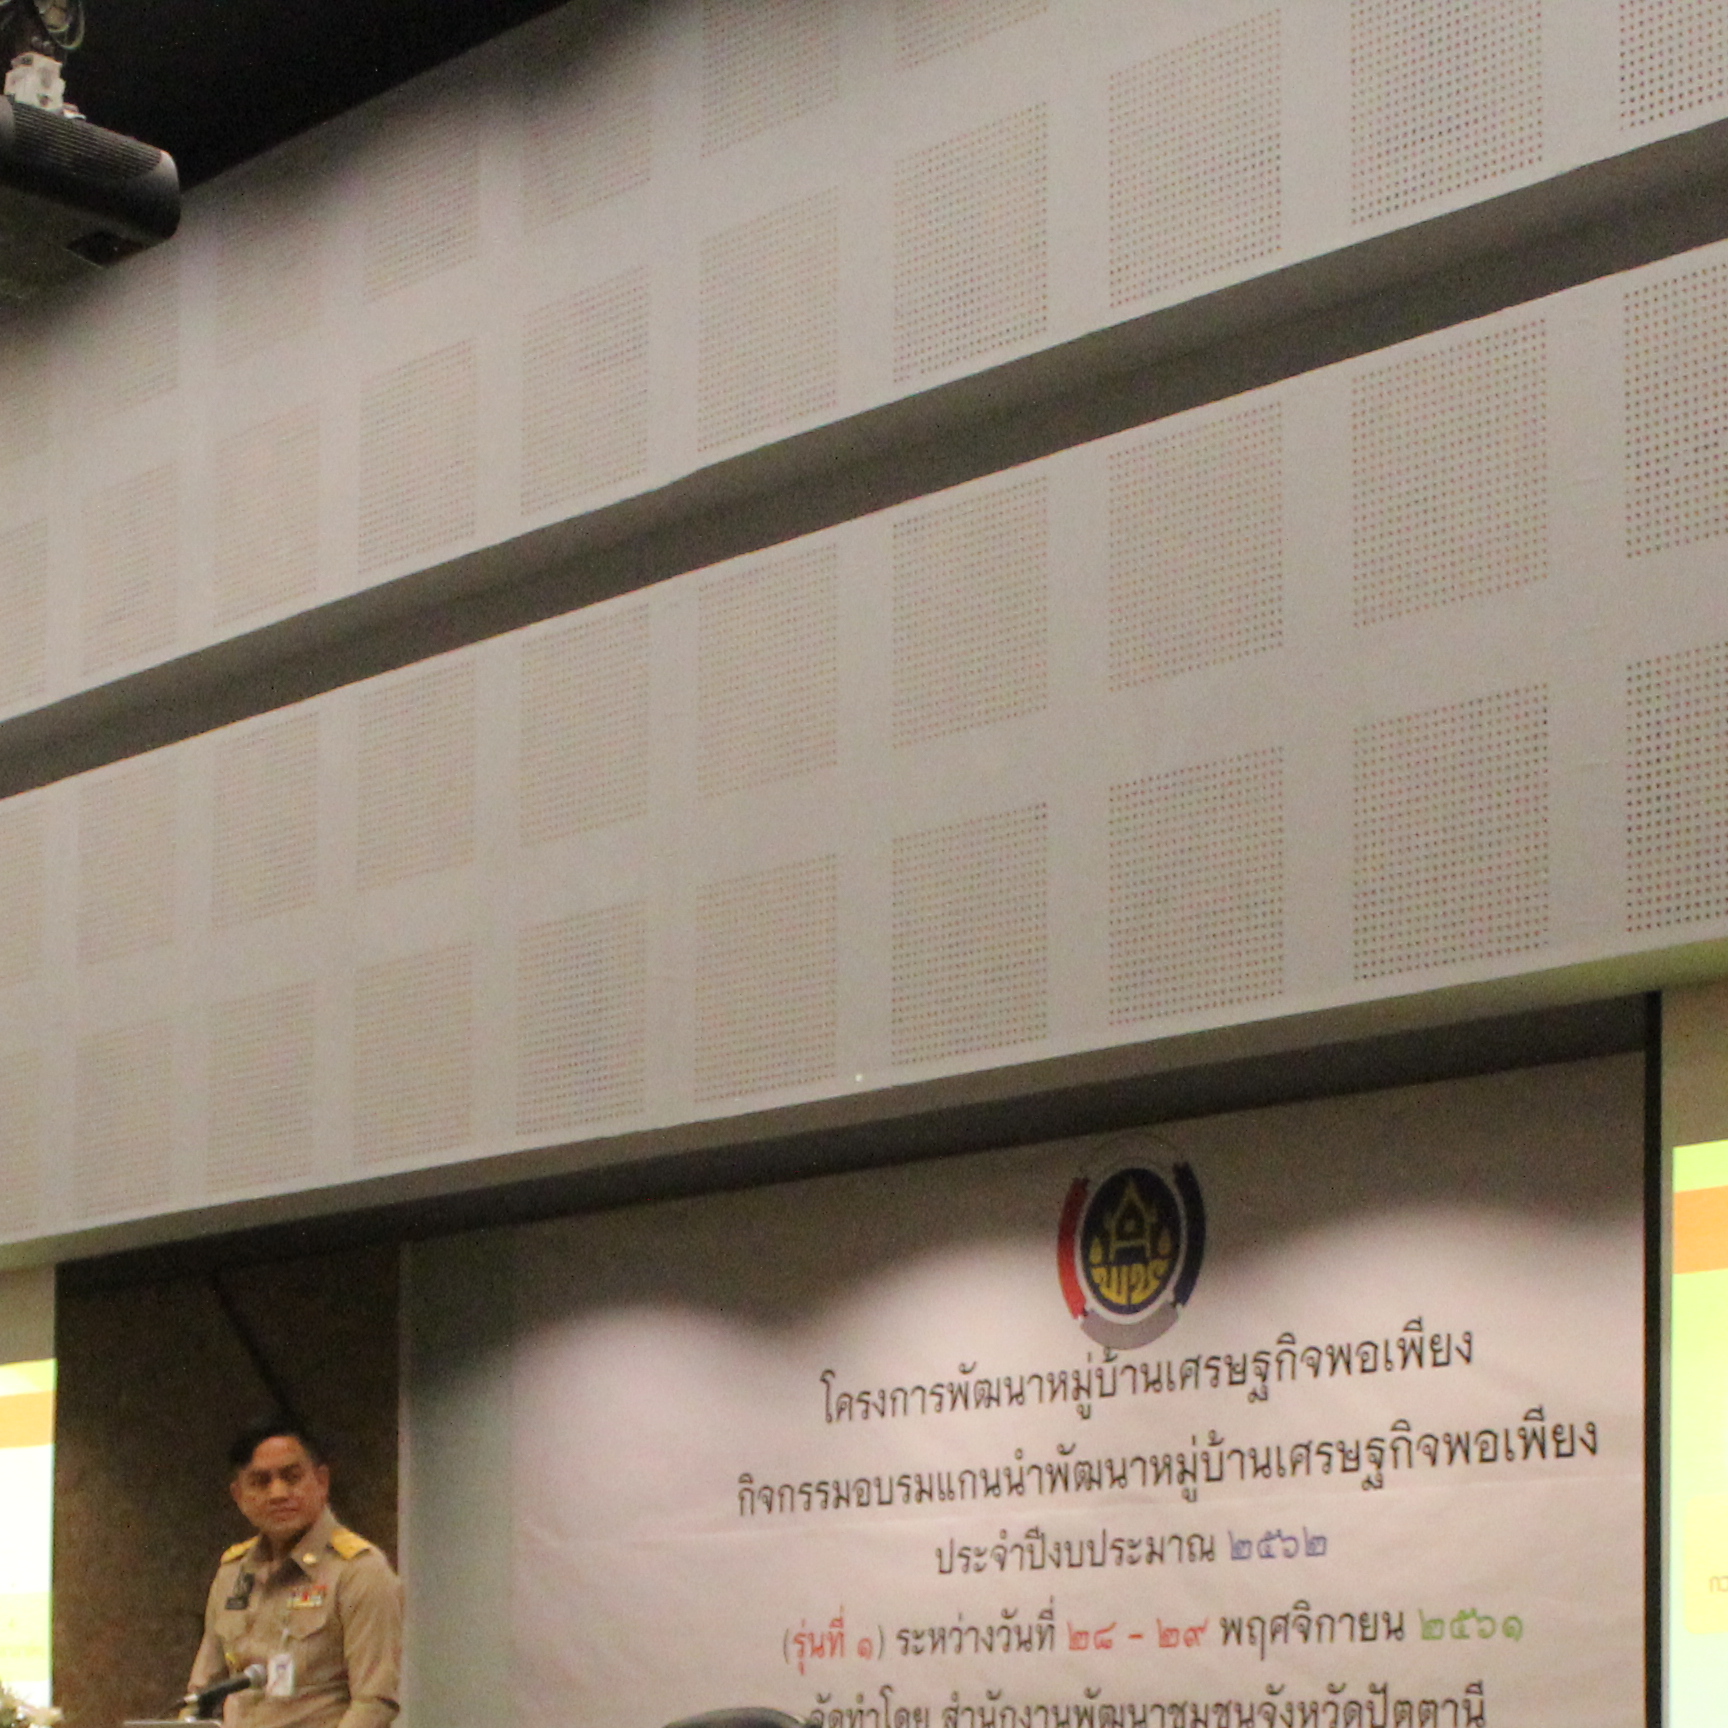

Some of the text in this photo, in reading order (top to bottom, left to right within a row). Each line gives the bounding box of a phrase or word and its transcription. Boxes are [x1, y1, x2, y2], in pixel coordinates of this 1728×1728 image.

[819, 1315, 1473, 1424] โครงการพัฒนาหมู่บ้านเศรษฐกิจพอเพียง
[737, 1404, 1599, 1517] กิจกรรมอบรมแกนนำพัฒนาหมู่บ้านเศรษฐกิจพอเพียง
[935, 1525, 1328, 1575] ประจำปีงบประมาณ ๒๕๖๒
[782, 1604, 846, 1676] (รุ่นที่
[896, 1595, 1057, 1656] ระหว่างวันที่
[1066, 1619, 1118, 1652] ๒๘
[1155, 1616, 1210, 1650] ๒๙
[1218, 1599, 1406, 1661] พฤศจิกายน
[1418, 1606, 1525, 1643] ๒๕๖๑
